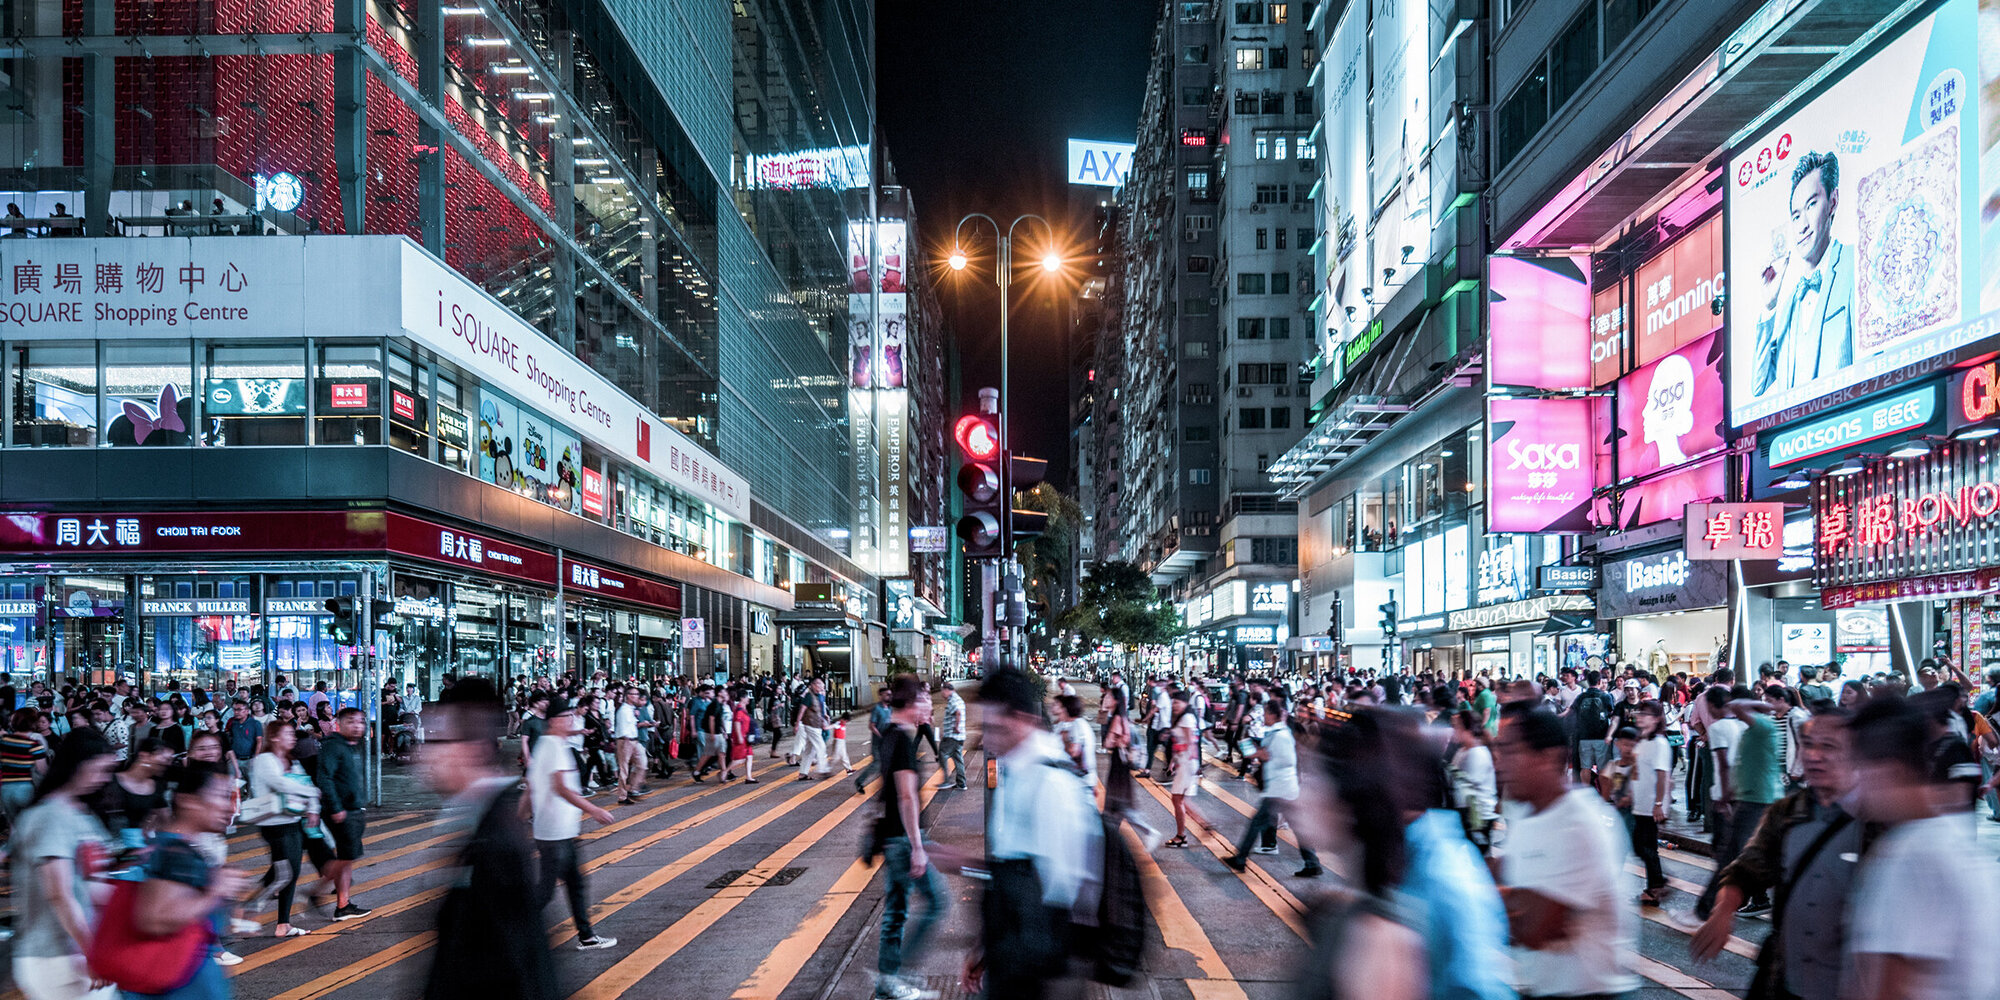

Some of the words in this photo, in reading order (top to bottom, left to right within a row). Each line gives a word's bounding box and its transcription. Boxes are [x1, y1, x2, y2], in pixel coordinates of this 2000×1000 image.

[1078, 150, 1133, 182] AX
[13, 260, 248, 295] 廣場購物中心
[95, 303, 177, 326] Shopping
[184, 302, 248, 321] Centre
[1347, 331, 1371, 367] Holiday
[1371, 319, 1383, 343] Inn
[452, 303, 519, 374] SQUARE
[526, 354, 576, 414] Shopping
[579, 390, 611, 428] Centre
[1780, 388, 1854, 423] NETWORK
[1861, 350, 1957, 397] 27230020
[890, 417, 900, 481] EMPEROR
[1737, 434, 1755, 450] JM
[1778, 417, 1862, 458] watsons
[56, 518, 140, 546] 周大福
[156, 526, 188, 537] CHOW
[190, 526, 208, 537] TAI
[211, 526, 241, 536] FOOK
[440, 530, 482, 563] 周大福
[572, 564, 599, 589] 周大福
[144, 603, 192, 613] FRANCK
[197, 602, 247, 613] MULLER
[268, 602, 317, 612] FRANCK
[1665, 593, 1677, 602] life
[1828, 590, 1854, 606] SALE
